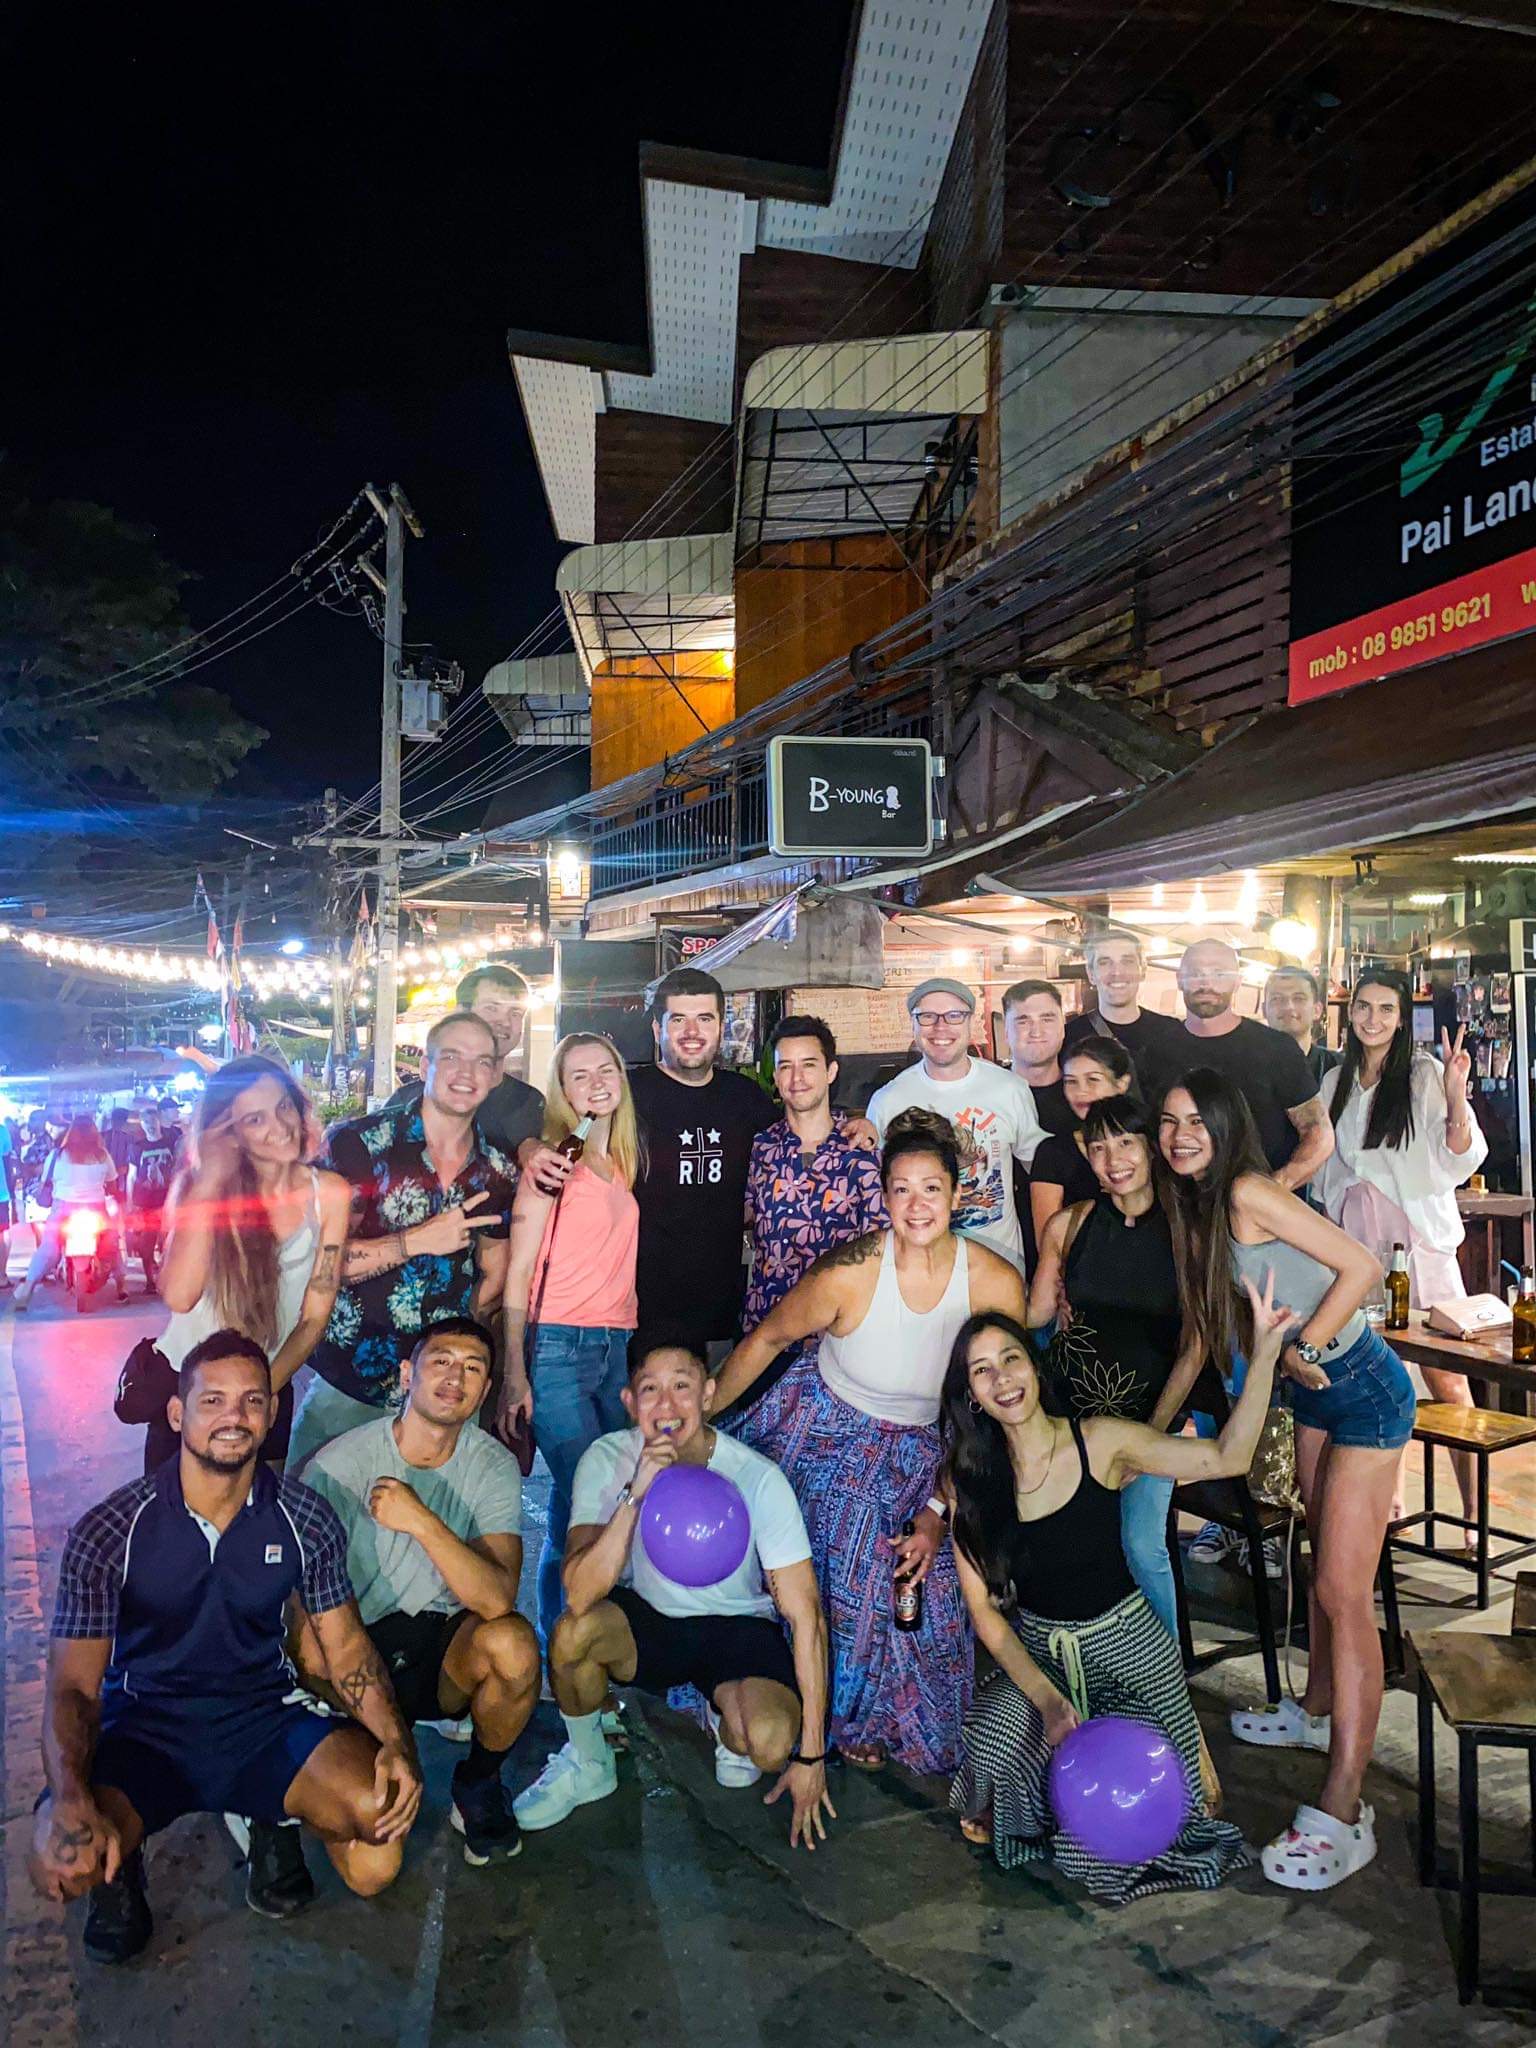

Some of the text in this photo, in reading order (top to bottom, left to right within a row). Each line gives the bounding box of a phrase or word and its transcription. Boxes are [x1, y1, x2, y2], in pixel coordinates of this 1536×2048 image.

[1402, 476, 1536, 564] Pai Lan
[1309, 645, 1347, 679] mob
[1362, 631, 1386, 661] 08
[1391, 612, 1436, 650] 9851
[1441, 592, 1491, 633] 9621
[809, 776, 884, 813] B-YOUNG
[881, 809, 896, 819] Bar
[679, 1158, 722, 1185] R 8
[896, 1595, 916, 1607] LEO
